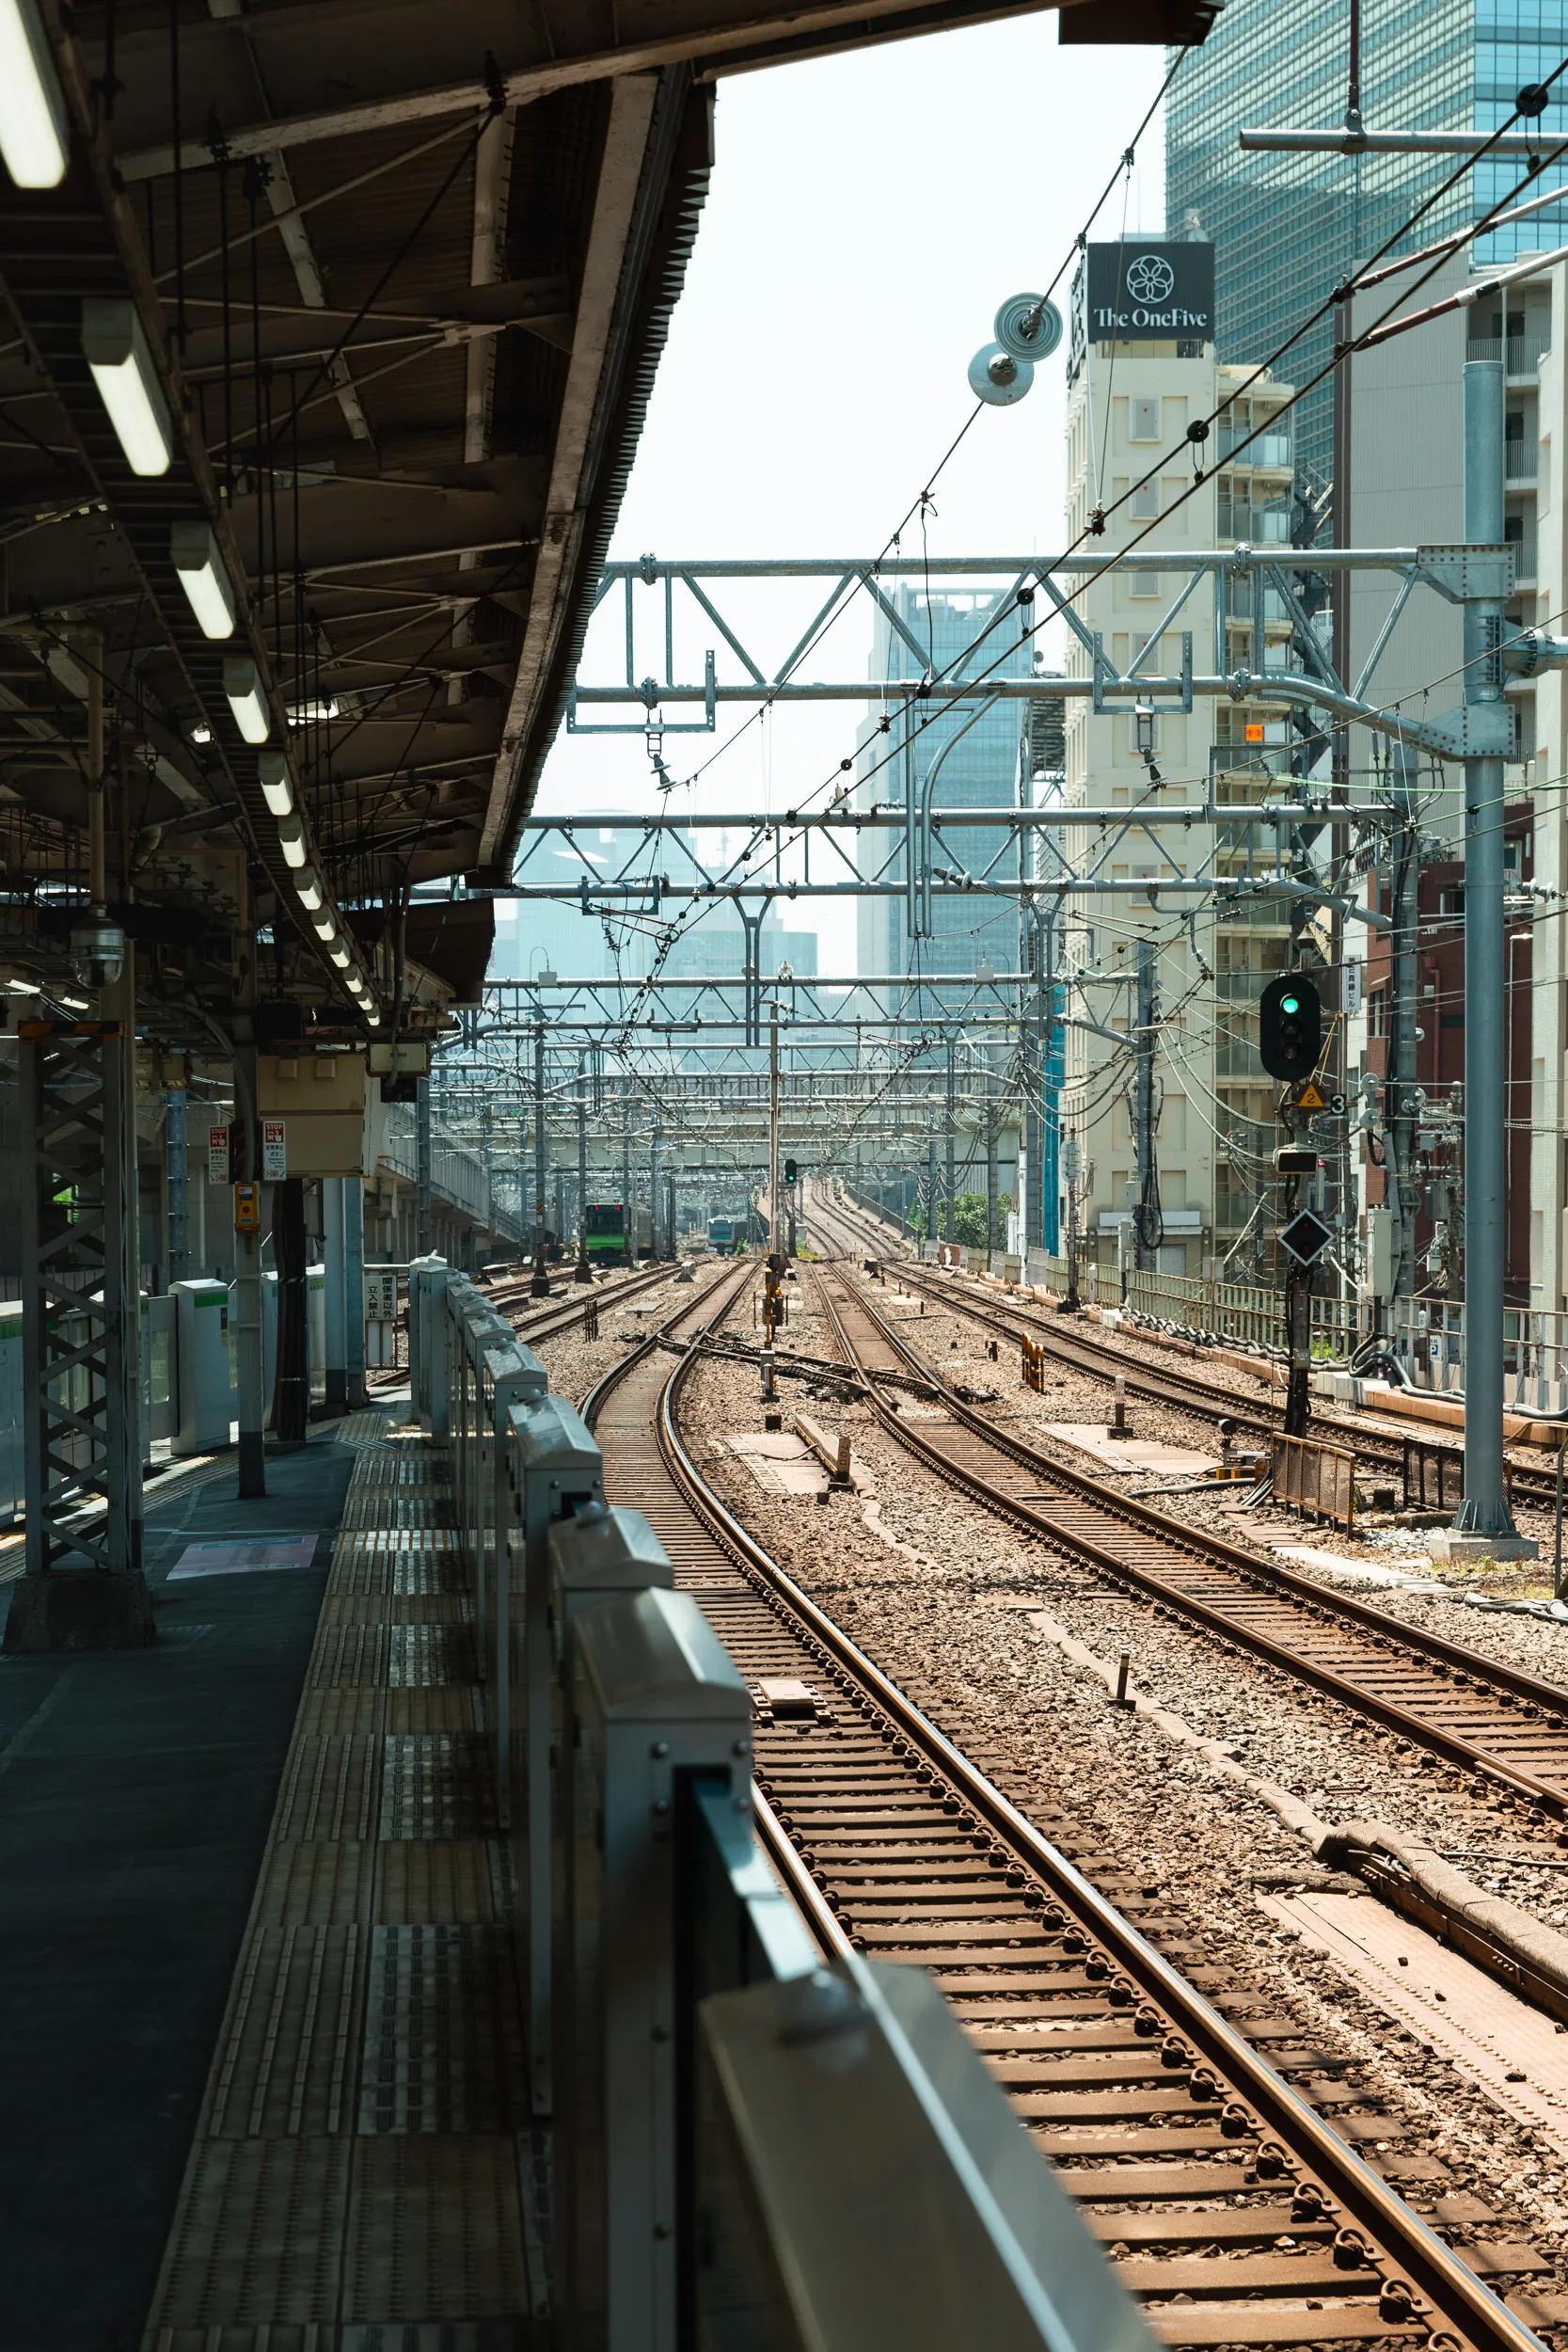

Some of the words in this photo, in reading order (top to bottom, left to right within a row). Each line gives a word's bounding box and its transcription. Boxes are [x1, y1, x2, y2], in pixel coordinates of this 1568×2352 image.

[1093, 307, 1129, 327] The
[1132, 308, 1208, 327] OneFive
[1307, 1093, 1316, 1104] 2
[1331, 1094, 1345, 1114] 3
[368, 1286, 378, 1318] 立入禁止
[382, 1277, 393, 1318] 関係者以外
